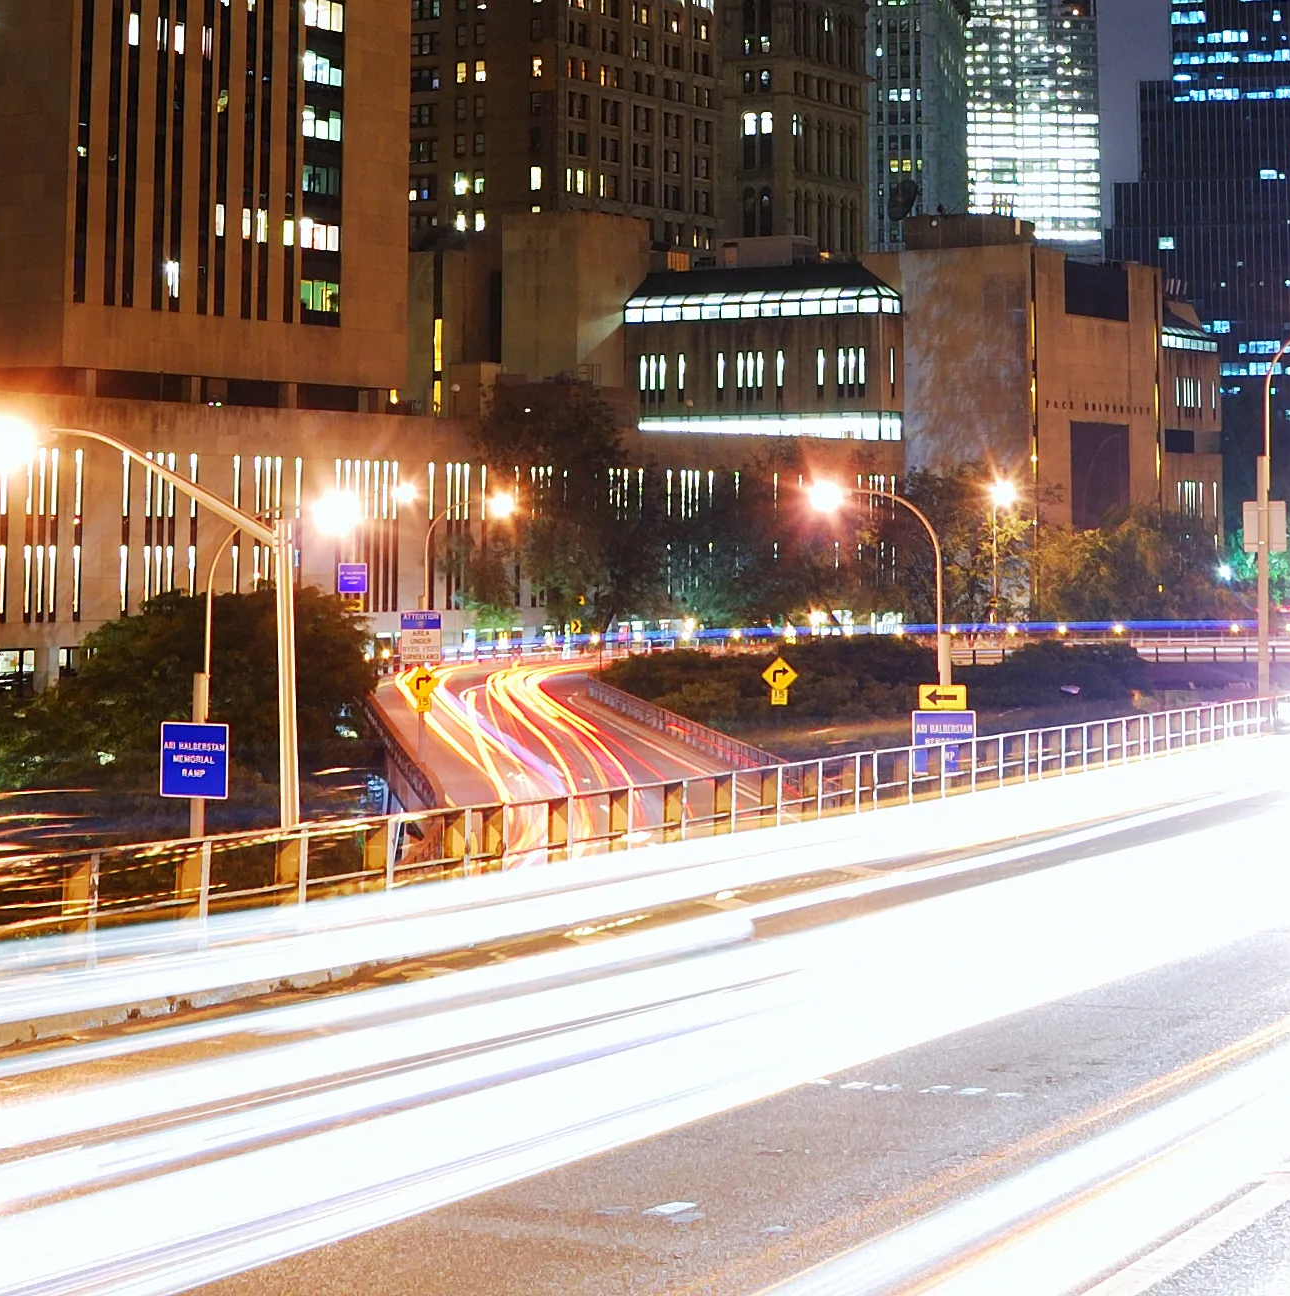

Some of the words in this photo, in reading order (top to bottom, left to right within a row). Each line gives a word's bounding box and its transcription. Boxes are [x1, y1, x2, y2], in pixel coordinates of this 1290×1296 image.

[1045, 400, 1074, 410] PACE
[774, 689, 785, 699] 15
[418, 697, 429, 706] 15
[173, 754, 215, 764] MEMORIAL
[182, 768, 206, 777] RAMP
